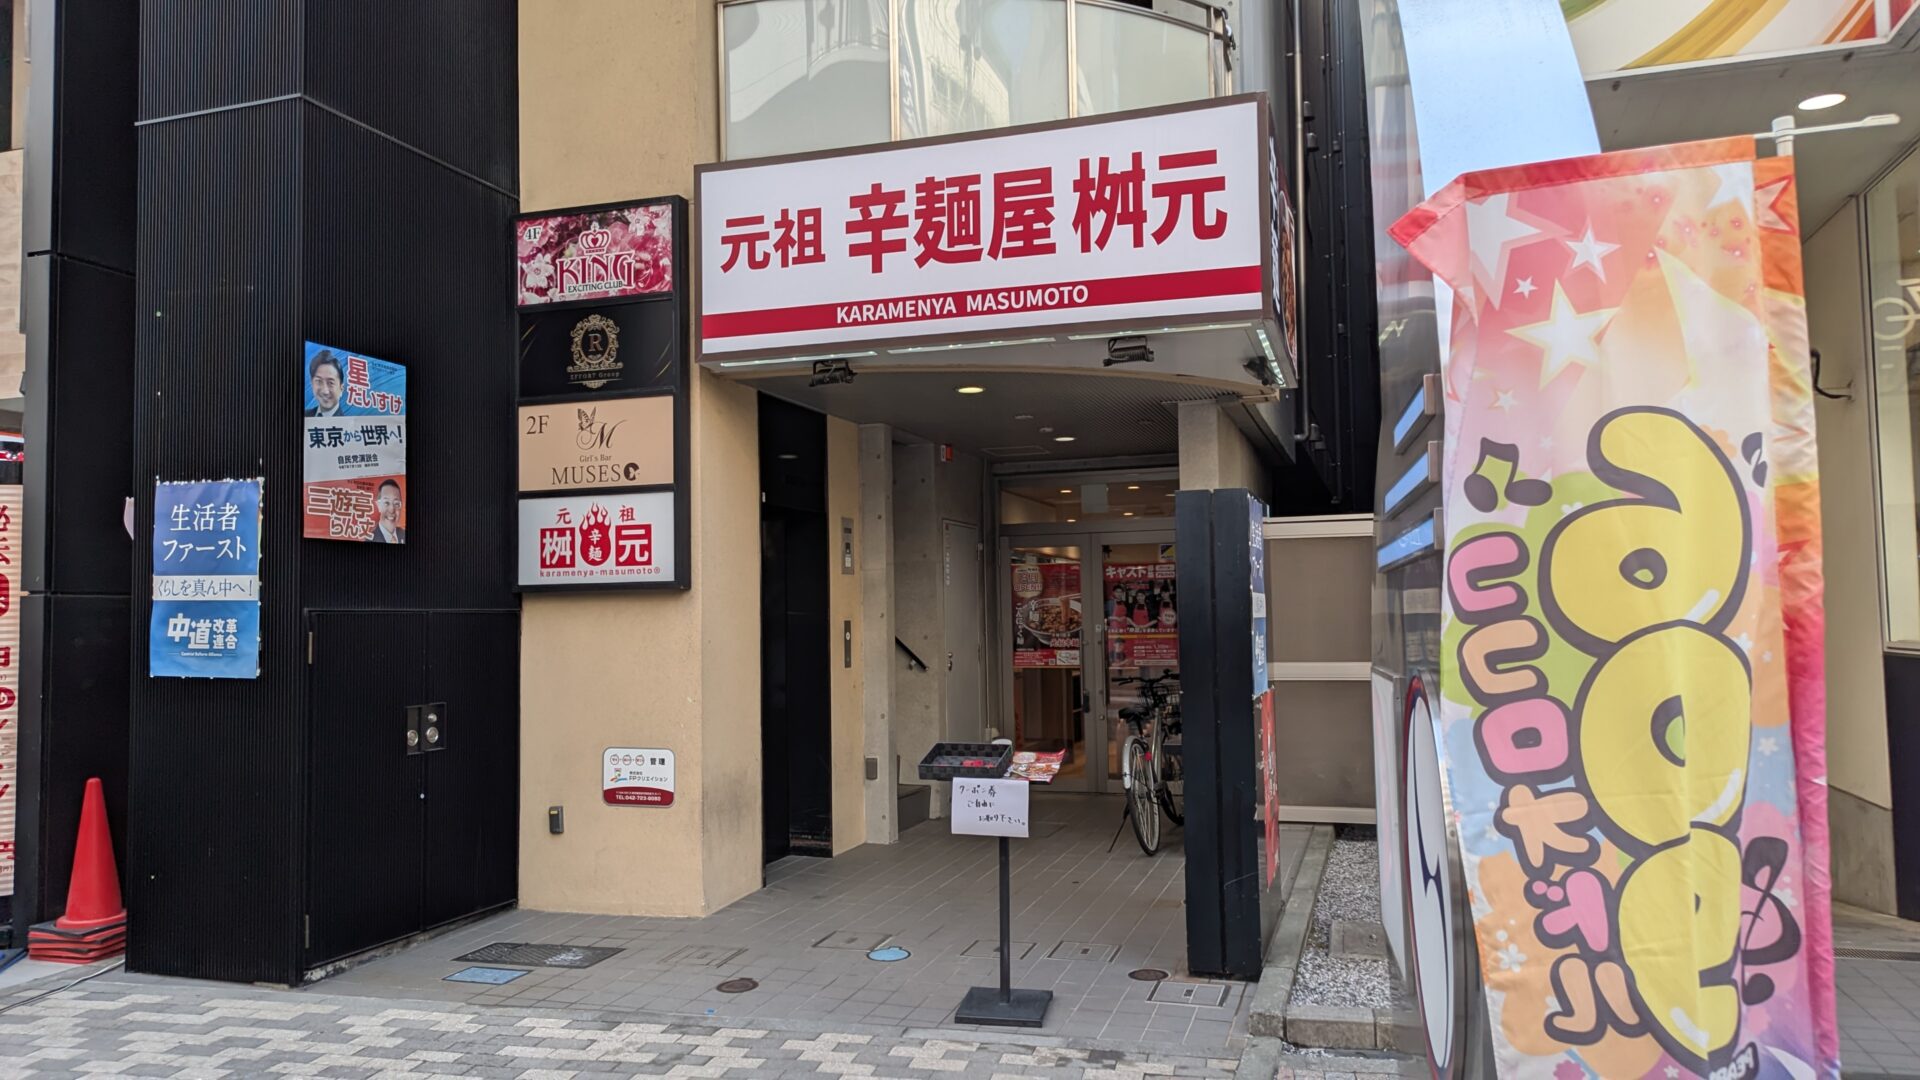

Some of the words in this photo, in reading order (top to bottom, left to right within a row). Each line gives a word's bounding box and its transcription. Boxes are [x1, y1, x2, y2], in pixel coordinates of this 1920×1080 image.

[720, 206, 826, 274] 元祖
[846, 166, 1057, 274] 辛麺屋
[1072, 149, 1228, 253] 桝元
[525, 227, 541, 240] 4F
[557, 253, 635, 294] KING
[568, 283, 603, 293] EXCITING
[604, 280, 623, 290] CLUB
[836, 297, 957, 324] KARAMENYA
[966, 285, 1089, 313] MASUMOTO
[588, 333, 604, 352] R
[348, 356, 370, 388] 星
[348, 385, 402, 413] だいすけ
[526, 415, 550, 435] 2F
[308, 425, 403, 449] 東京から世界へ!
[337, 453, 378, 465] 自民党演説会
[600, 454, 612, 462] Bar
[552, 464, 621, 485] MUSES
[307, 486, 374, 519] 三遊亭
[170, 503, 240, 532] 生活者
[555, 507, 572, 525] 元
[619, 505, 636, 522] 祖
[330, 517, 375, 540] らん丈
[162, 535, 247, 562] ファースト
[157, 578, 254, 598] くらしを真ん中へ！
[167, 612, 213, 650] 中道
[212, 617, 238, 634] 改革
[212, 634, 238, 650] 連合
